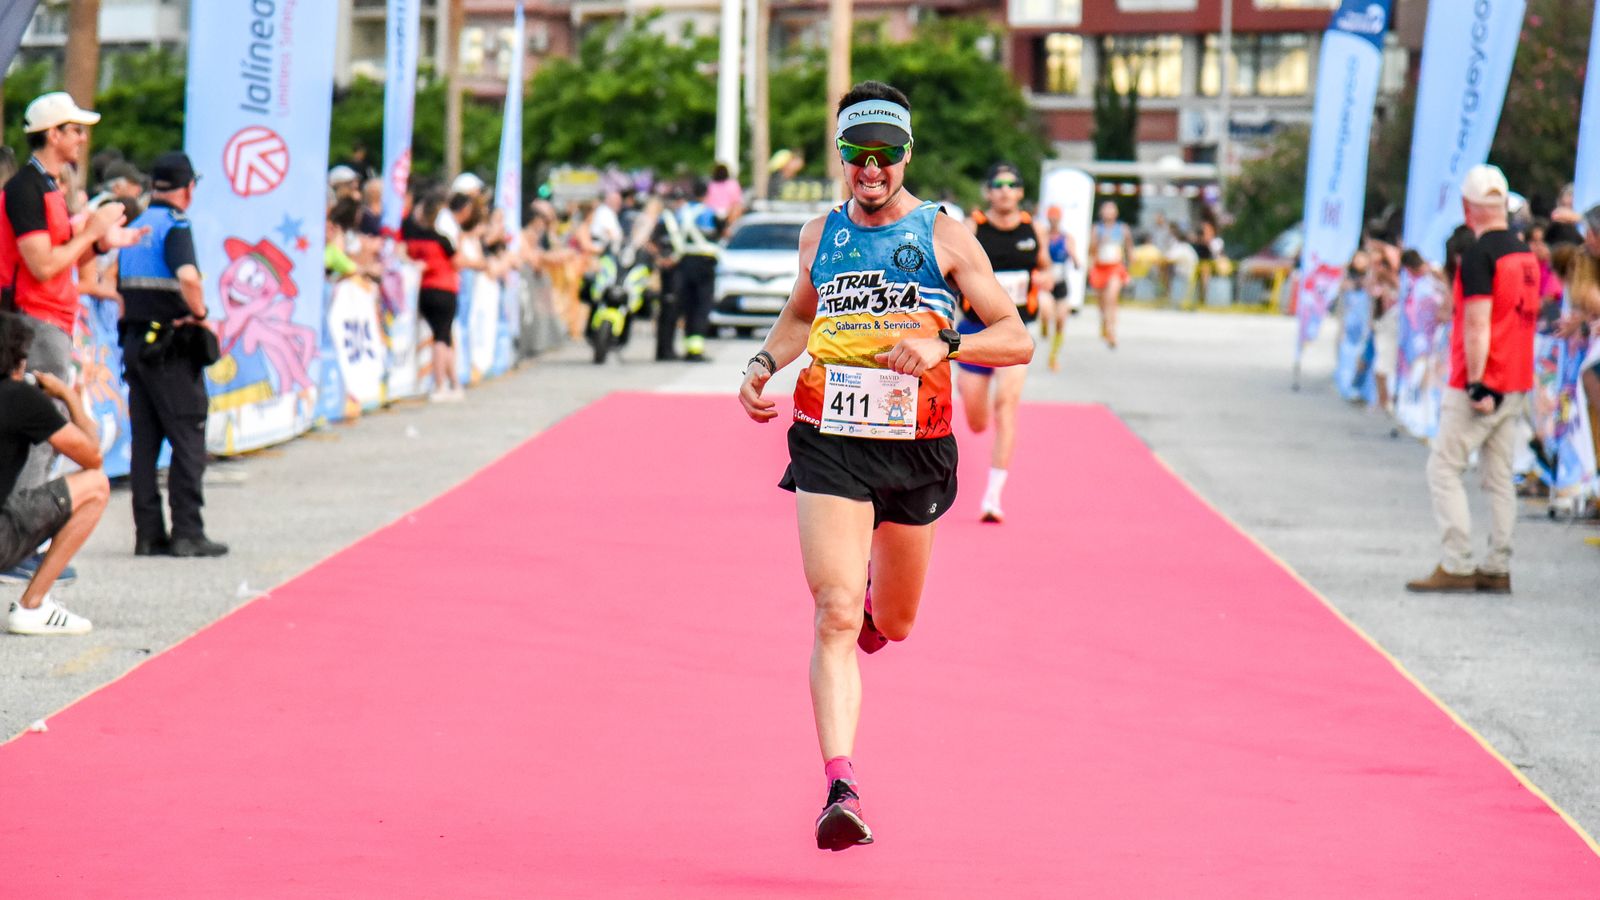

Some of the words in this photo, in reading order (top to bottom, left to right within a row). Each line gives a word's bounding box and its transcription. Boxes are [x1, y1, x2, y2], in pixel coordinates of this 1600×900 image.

[861, 110, 902, 121] LURBEL
[836, 274, 882, 294] TRAIL
[826, 294, 870, 313] TEAM
[835, 321, 872, 331] Gabarras
[874, 320, 881, 330] &
[883, 320, 921, 330] Servicios
[830, 371, 845, 383] XXI
[830, 391, 870, 418] 411
